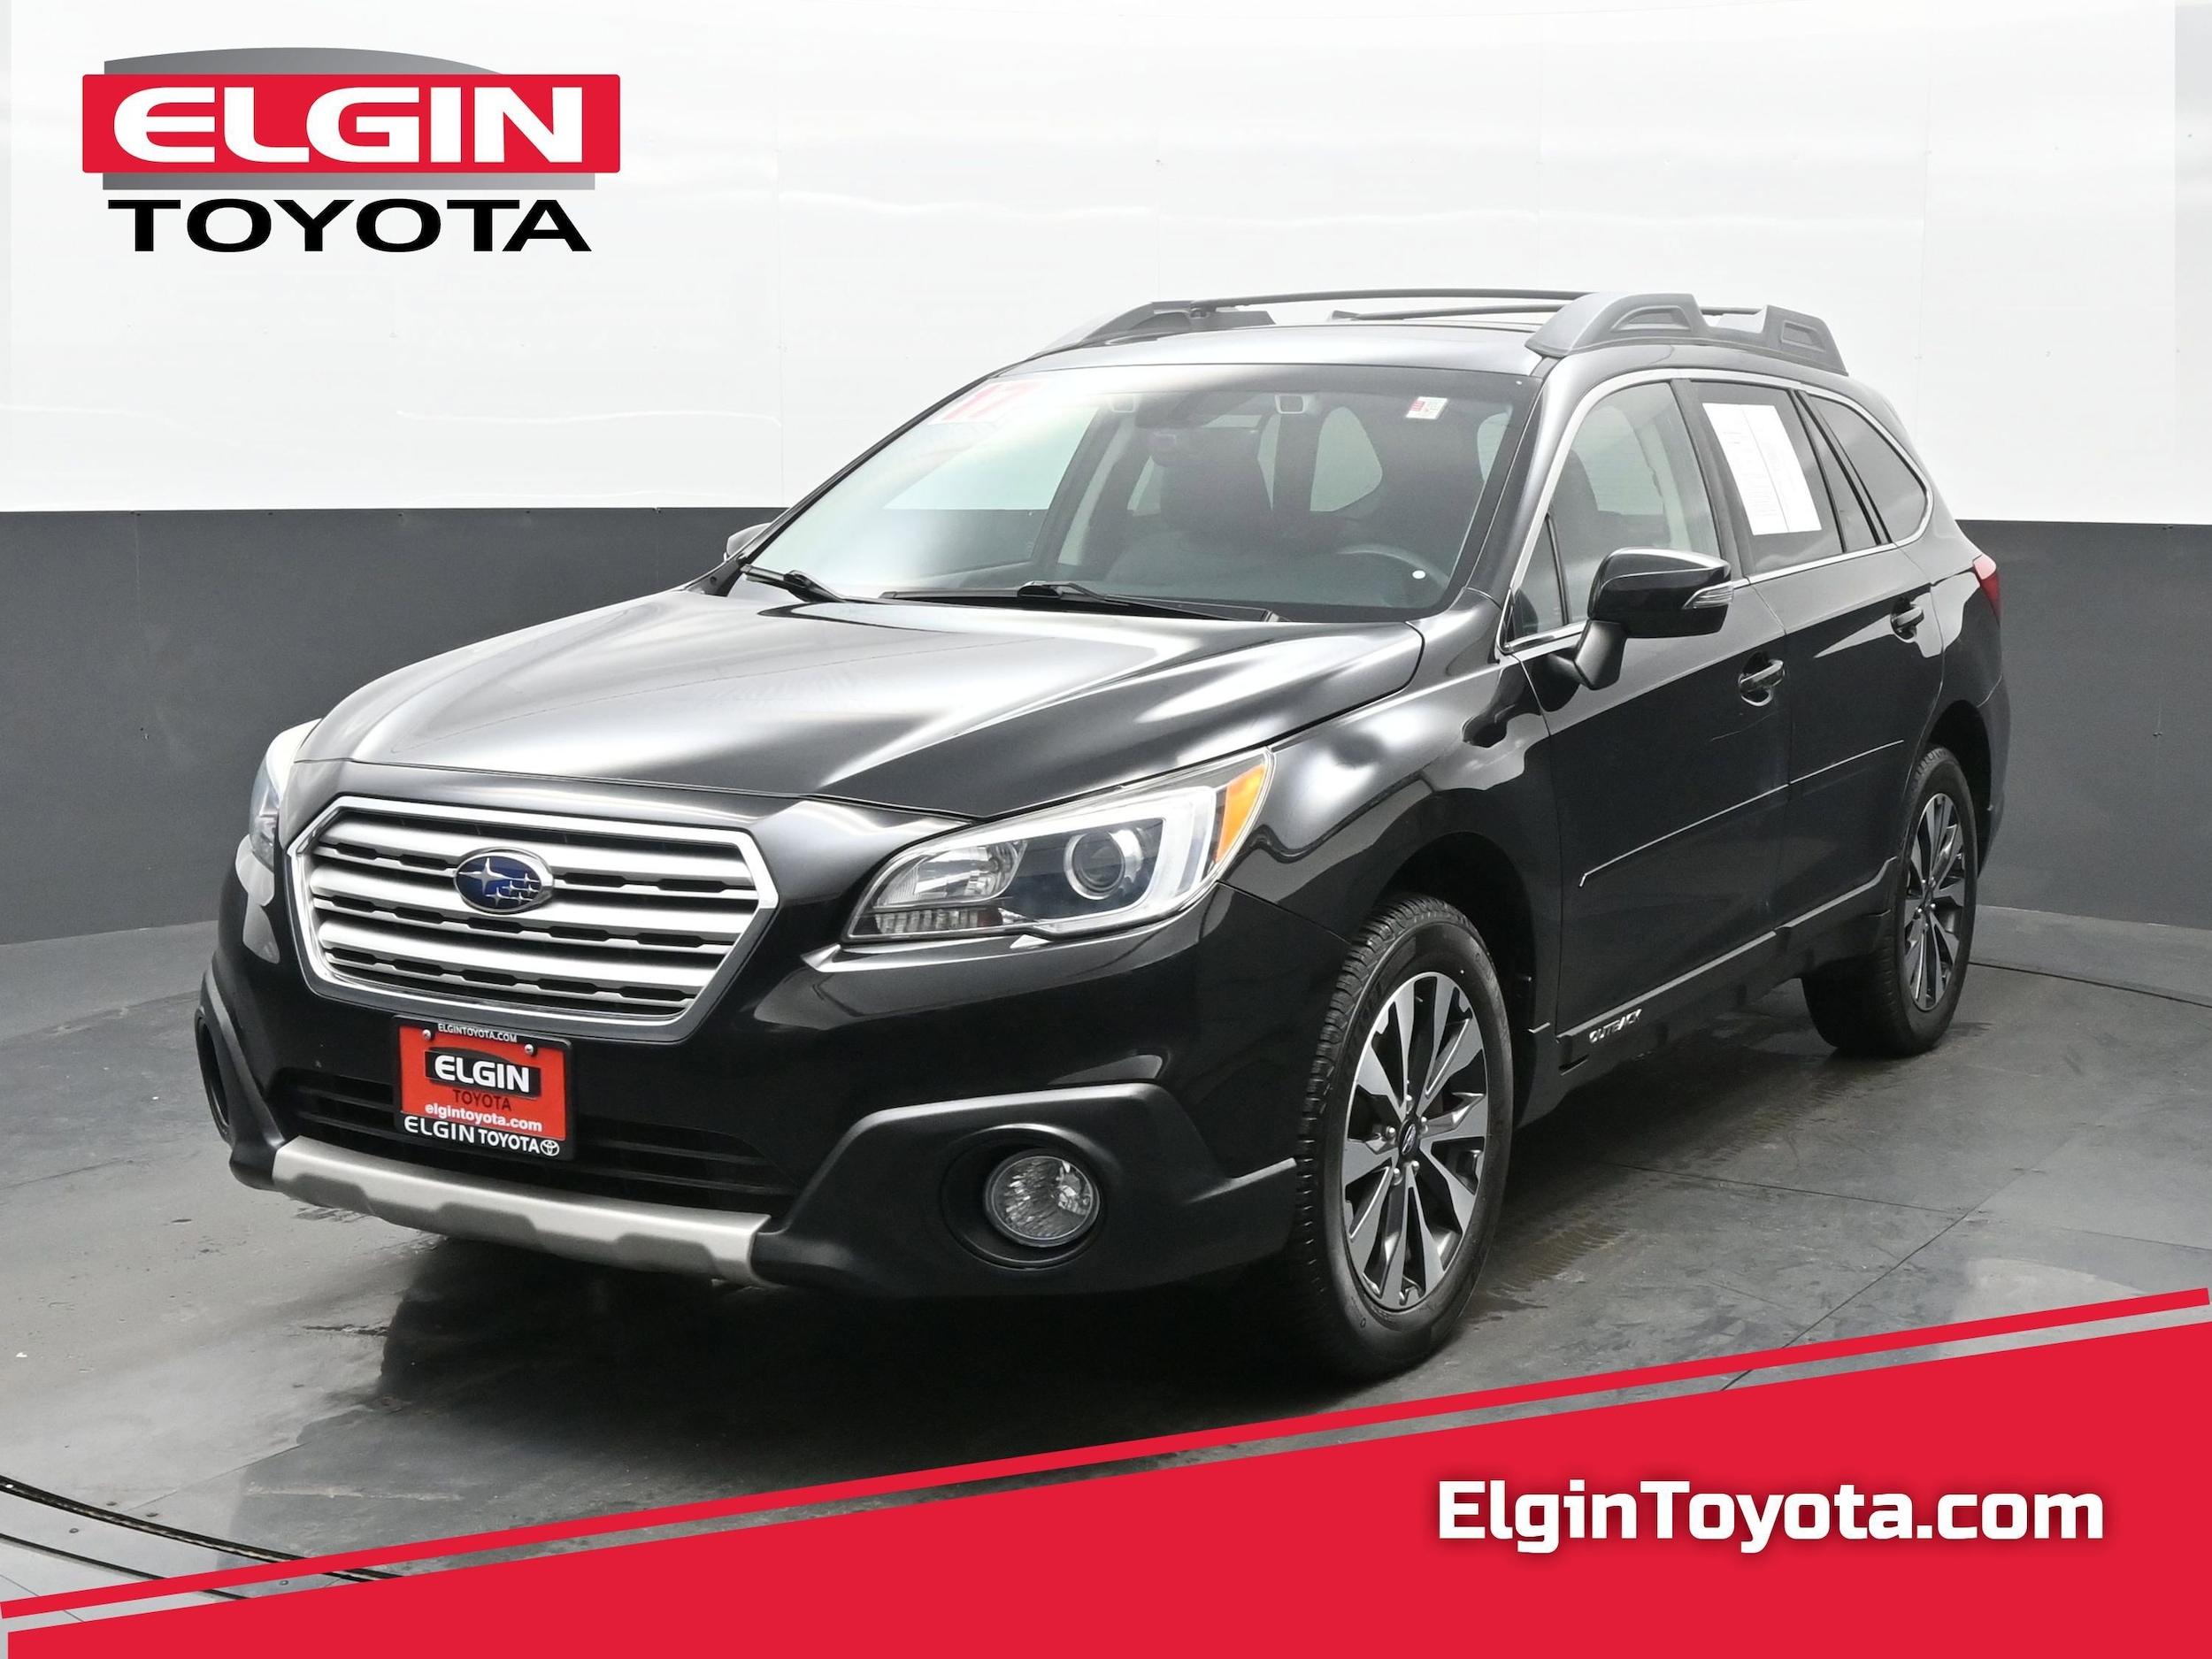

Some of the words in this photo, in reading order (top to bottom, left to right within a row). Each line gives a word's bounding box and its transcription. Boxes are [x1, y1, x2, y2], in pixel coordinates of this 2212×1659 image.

[438, 1024, 518, 1043] ELGINTOYOTA.COM
[434, 1055, 530, 1093] ELGIN
[452, 1089, 511, 1111] TOYOTA
[425, 1102, 542, 1132] elgintoyota.com
[404, 1116, 474, 1143] ELGIN
[478, 1129, 540, 1154] TOYOTA
